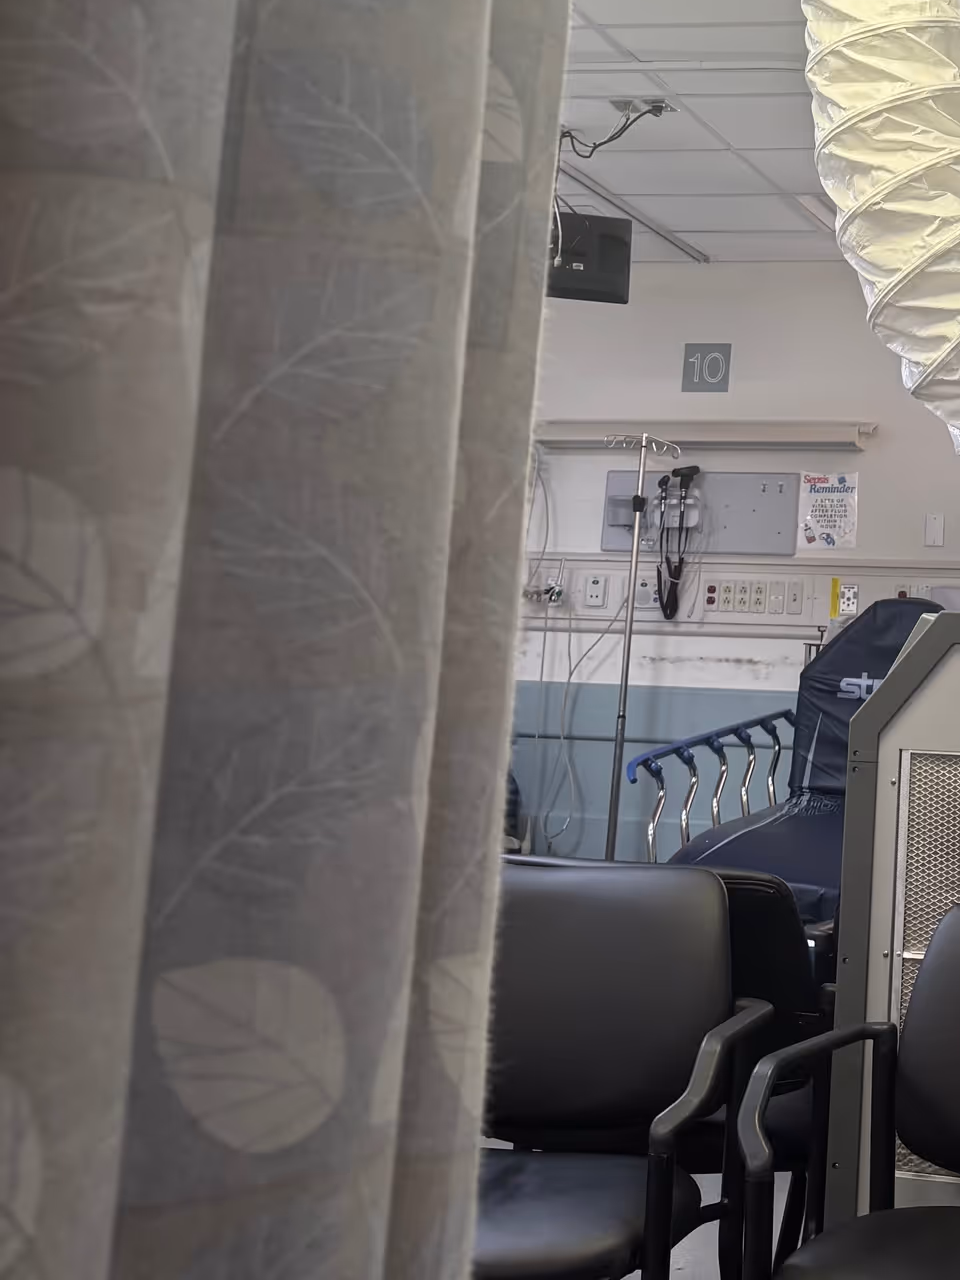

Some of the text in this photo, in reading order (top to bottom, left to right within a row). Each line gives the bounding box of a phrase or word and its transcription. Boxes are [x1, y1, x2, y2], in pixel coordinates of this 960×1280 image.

[688, 352, 726, 383] 10
[803, 475, 828, 484] Sepsis
[809, 484, 856, 494] Reminder
